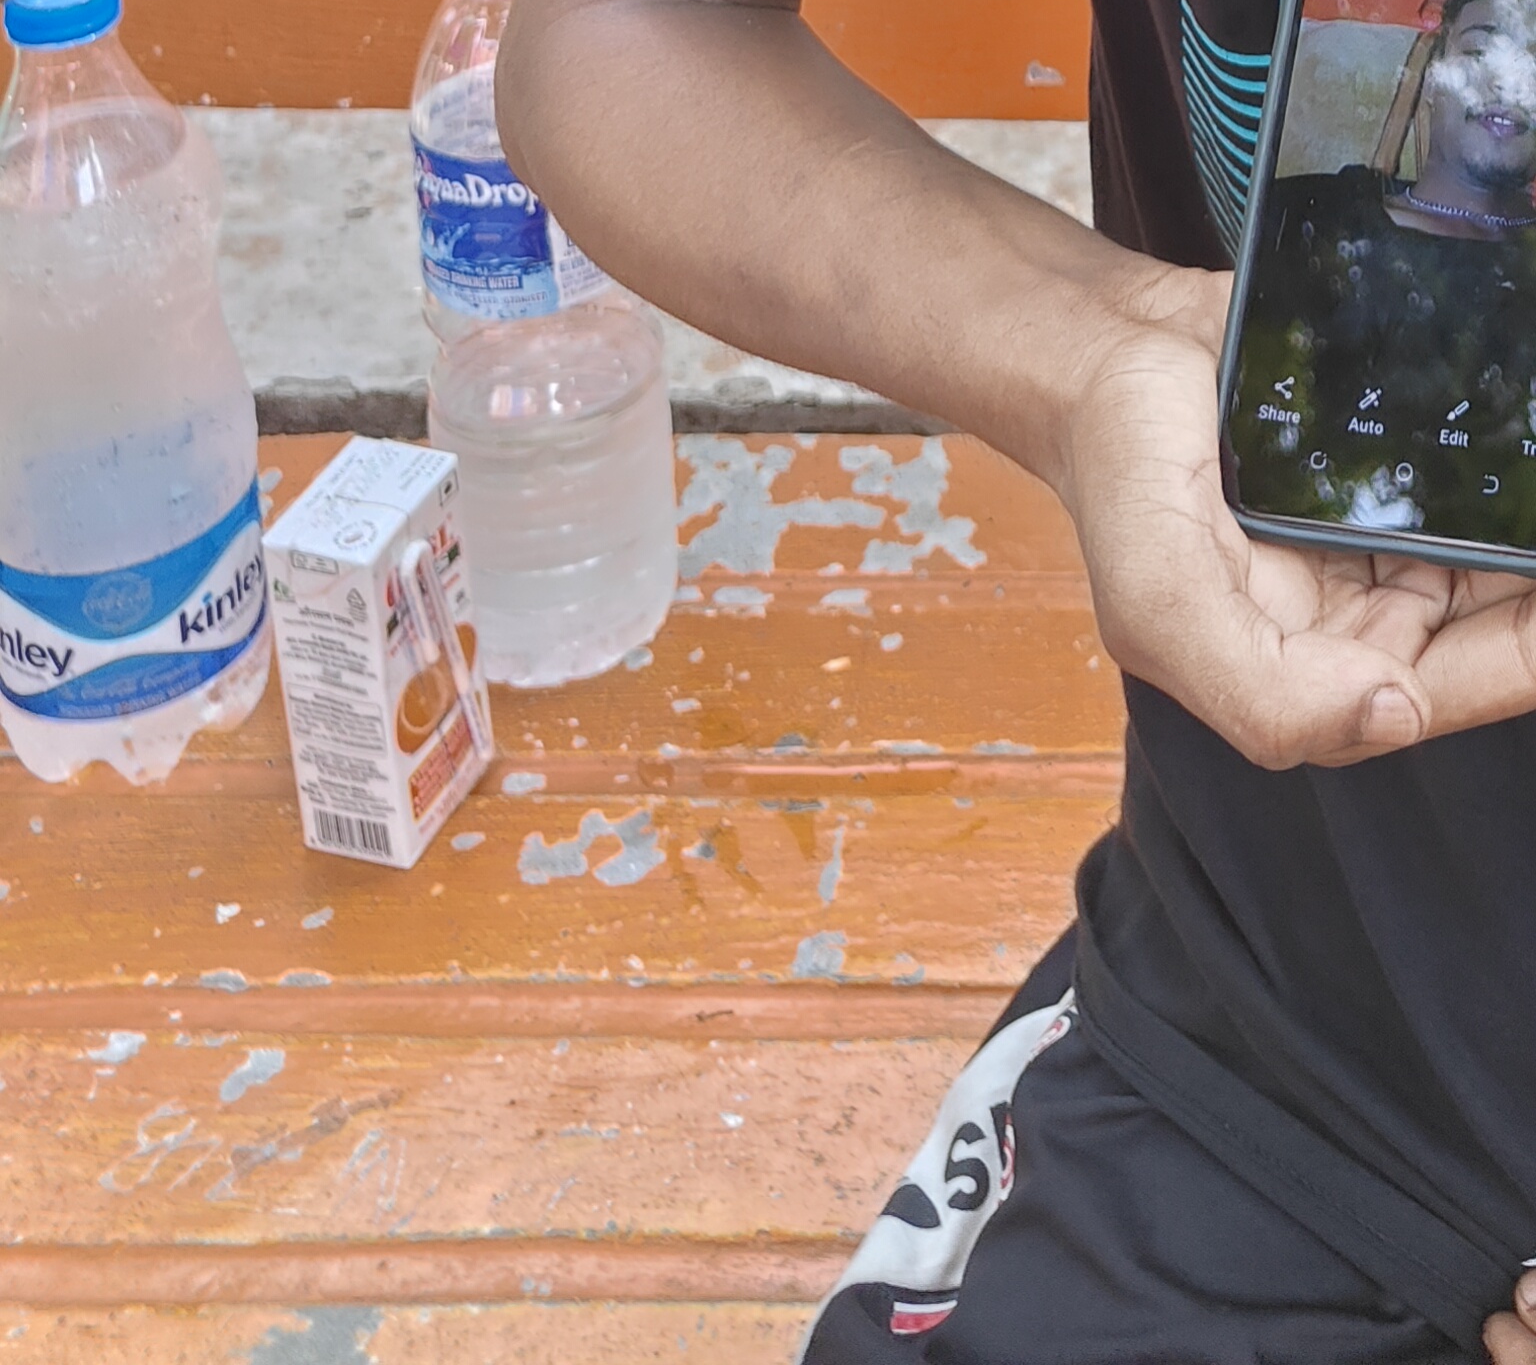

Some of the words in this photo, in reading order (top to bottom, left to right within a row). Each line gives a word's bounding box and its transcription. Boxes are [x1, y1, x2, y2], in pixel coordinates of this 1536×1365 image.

[488, 275, 521, 289] WATER
[1258, 403, 1301, 425] Share
[1347, 417, 1385, 436] Auto
[1439, 429, 1470, 448] Edit
[179, 555, 262, 643] kinley
